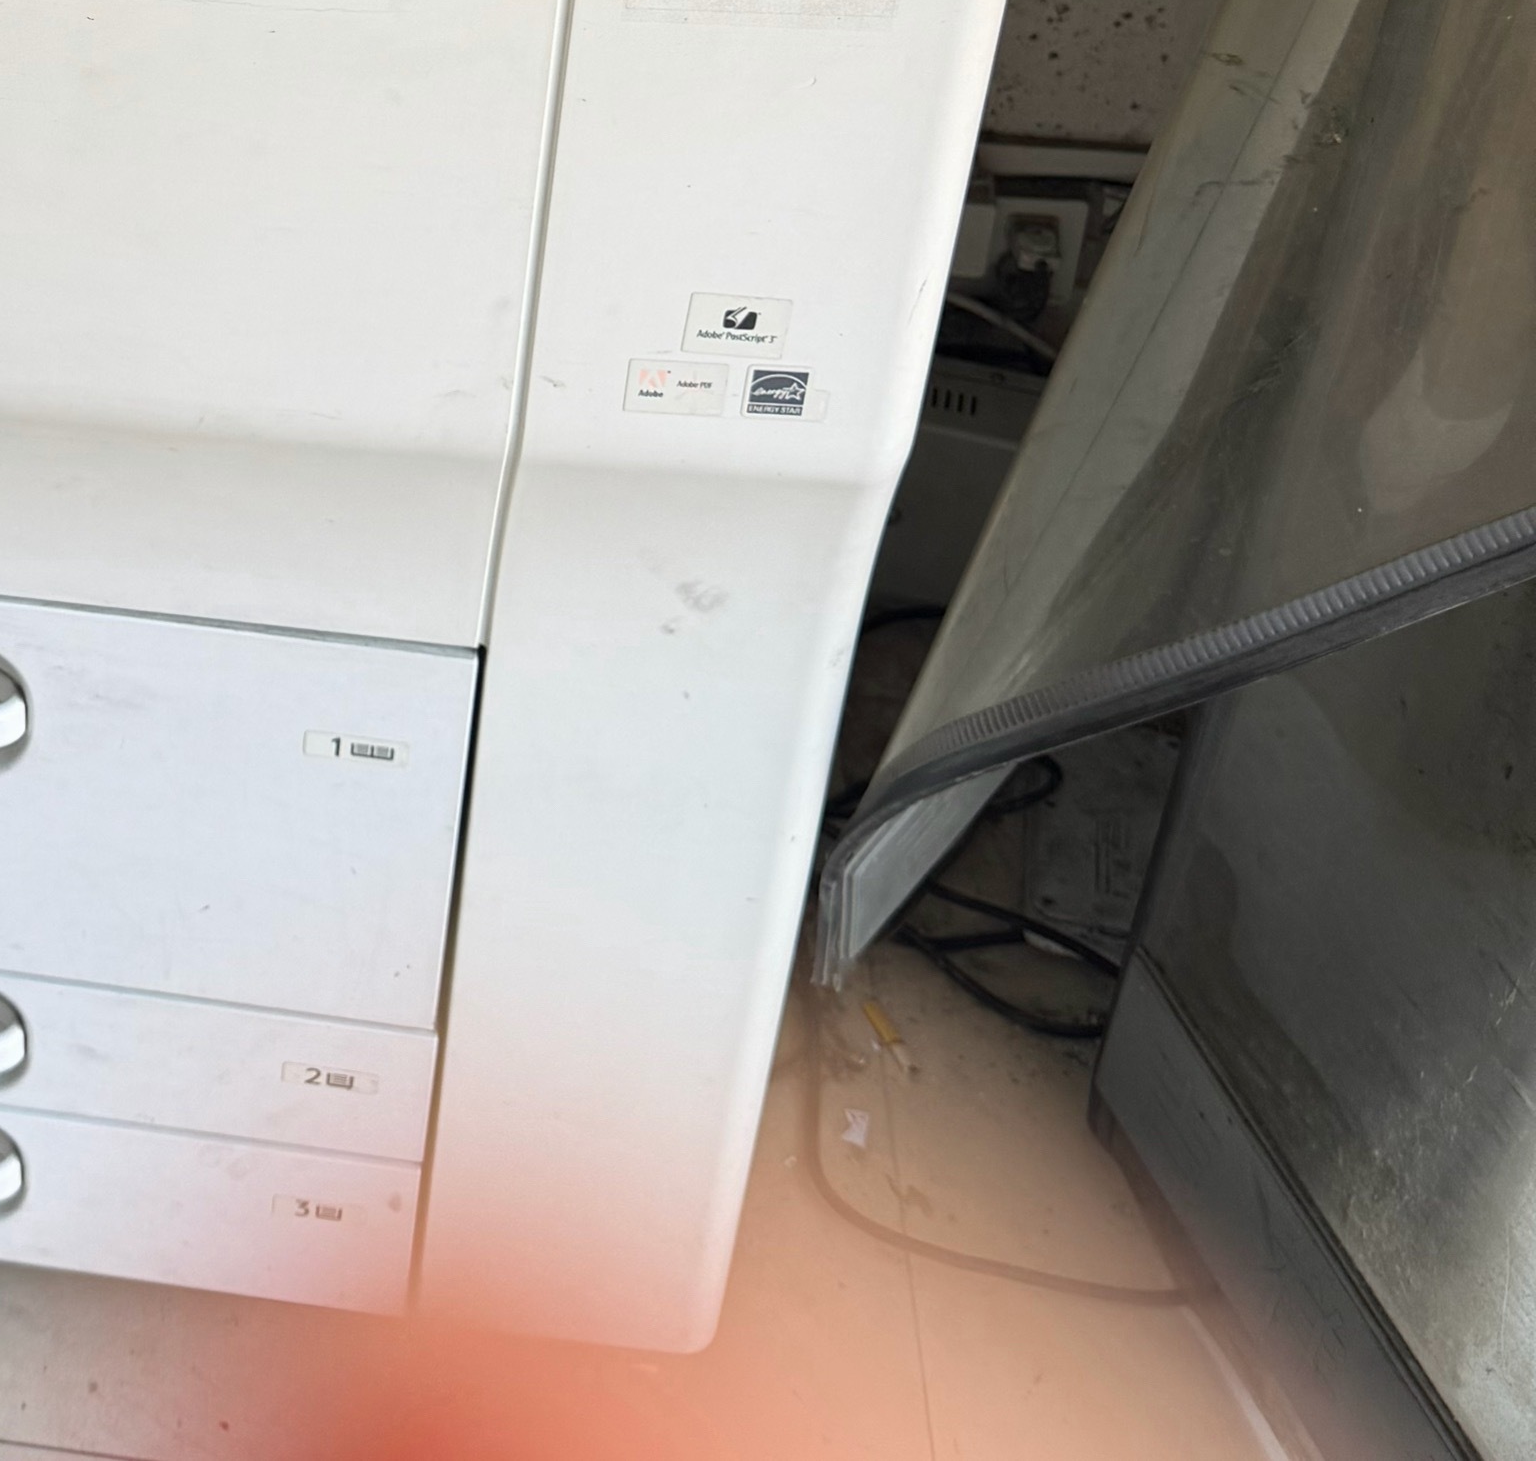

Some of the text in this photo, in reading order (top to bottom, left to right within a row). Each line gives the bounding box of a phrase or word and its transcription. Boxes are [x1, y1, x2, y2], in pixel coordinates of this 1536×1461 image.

[696, 329, 774, 343] Adobe PostScript 3
[638, 389, 664, 398] Adobe
[748, 405, 801, 415] ENERGY STAR
[332, 737, 341, 757] 1
[303, 1068, 322, 1085] 2
[294, 1199, 311, 1218] 3
